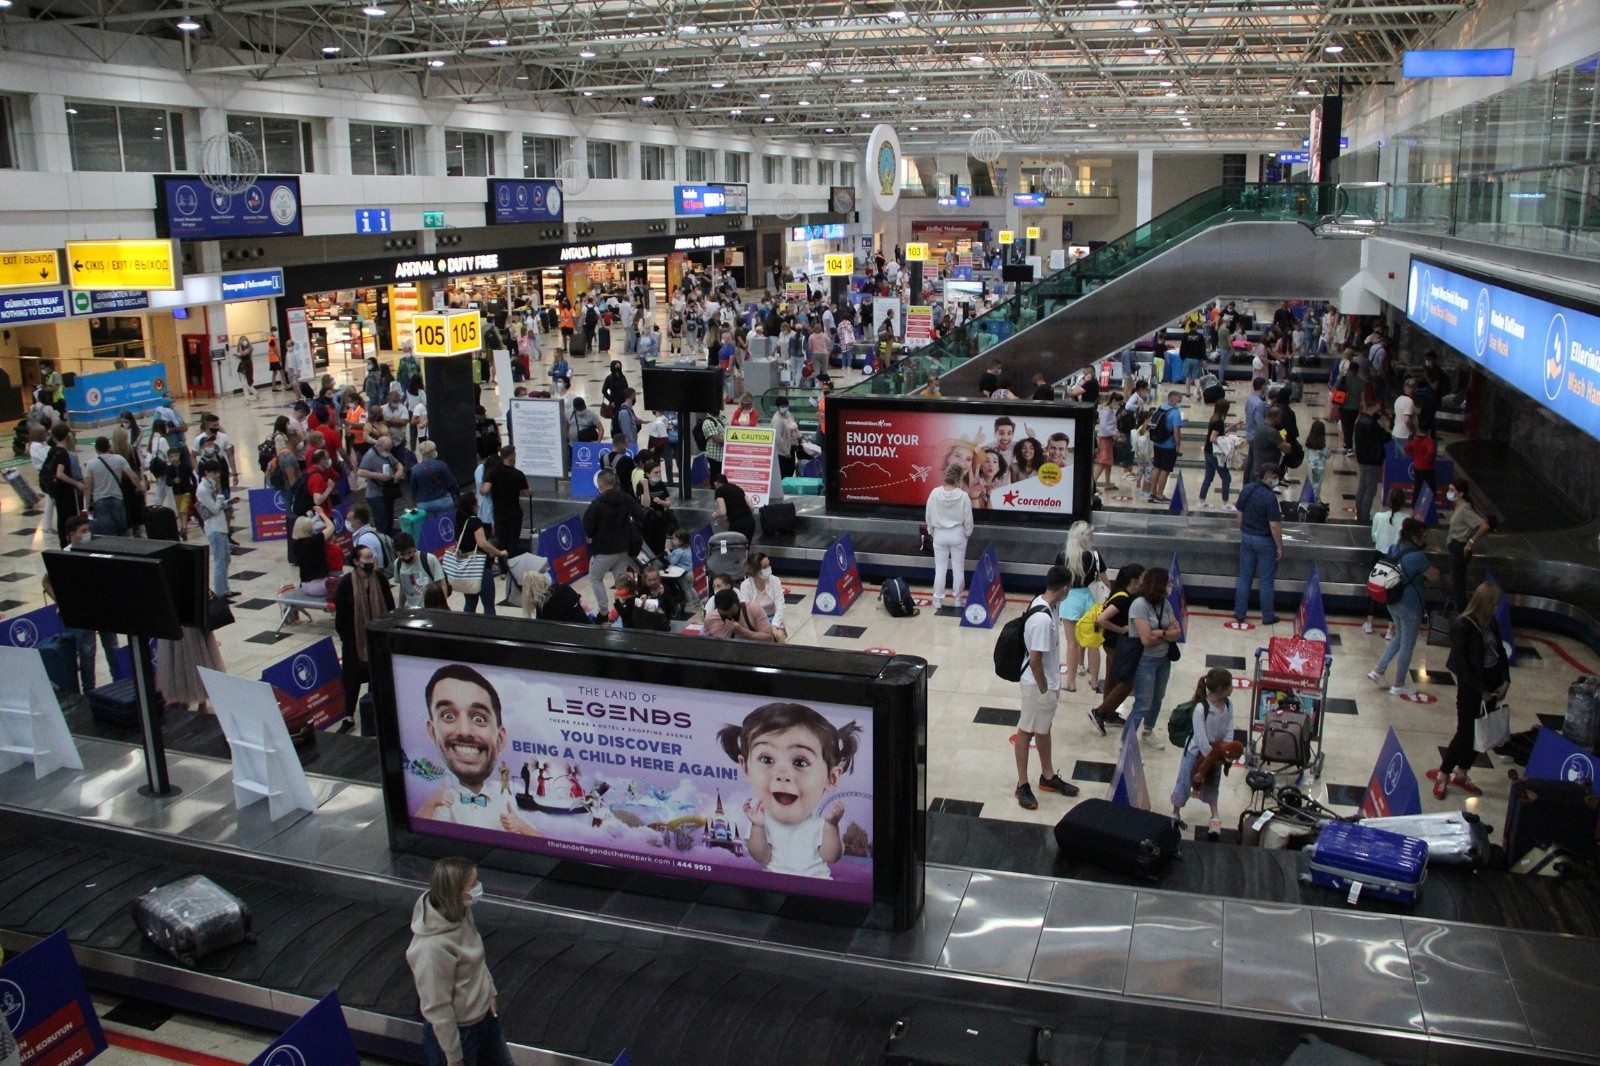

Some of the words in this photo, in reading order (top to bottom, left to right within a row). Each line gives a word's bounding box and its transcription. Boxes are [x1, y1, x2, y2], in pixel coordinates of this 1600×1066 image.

[3, 255, 17, 265] EXIT
[24, 254, 53, 264] ВЫХОД
[560, 245, 590, 260] ANTALYA
[597, 244, 615, 257] DUTY
[616, 242, 632, 255] FREE
[908, 247, 921, 256] 103
[85, 260, 105, 273] ÇIKIŞ
[112, 260, 127, 270] EXIT
[135, 259, 169, 271] ВЫХОД
[394, 260, 437, 278] ARRIVAL
[447, 256, 474, 273] DUTY
[475, 254, 498, 270] FREE
[827, 259, 842, 270] 104
[4, 298, 41, 309] GÜMRÜKTEN
[1, 309, 28, 319] NOTHING
[29, 308, 37, 317] TO
[38, 306, 64, 316] DECLARE
[415, 325, 445, 346] 105
[453, 321, 476, 344] 105
[741, 433, 770, 441] CAUTION
[846, 431, 883, 444] ENJOY
[886, 433, 919, 446] YOUR
[846, 444, 898, 458] HOLIDAY.
[1017, 497, 1062, 507] corendon
[578, 686, 599, 697] THE
[604, 689, 636, 701] LAND
[642, 693, 657, 703] OF
[547, 697, 692, 729] LEGENDS
[549, 717, 570, 725] THEME
[598, 723, 619, 731] HOTEL
[628, 727, 662, 736] SHOPPING
[666, 732, 693, 740] AVENUE
[560, 729, 593, 745] YOU
[598, 734, 682, 756] DISCOVER
[512, 740, 559, 757] BEING
[563, 747, 575, 759] A
[579, 749, 626, 767] CHILD
[630, 755, 674, 773] HERE
[678, 761, 738, 781] AGAIN!
[547, 841, 671, 866] thelandoflegendsthemepark.com
[677, 861, 692, 869] 444
[694, 863, 712, 872] 9913
[36, 1022, 73, 1051] KORUYUN
